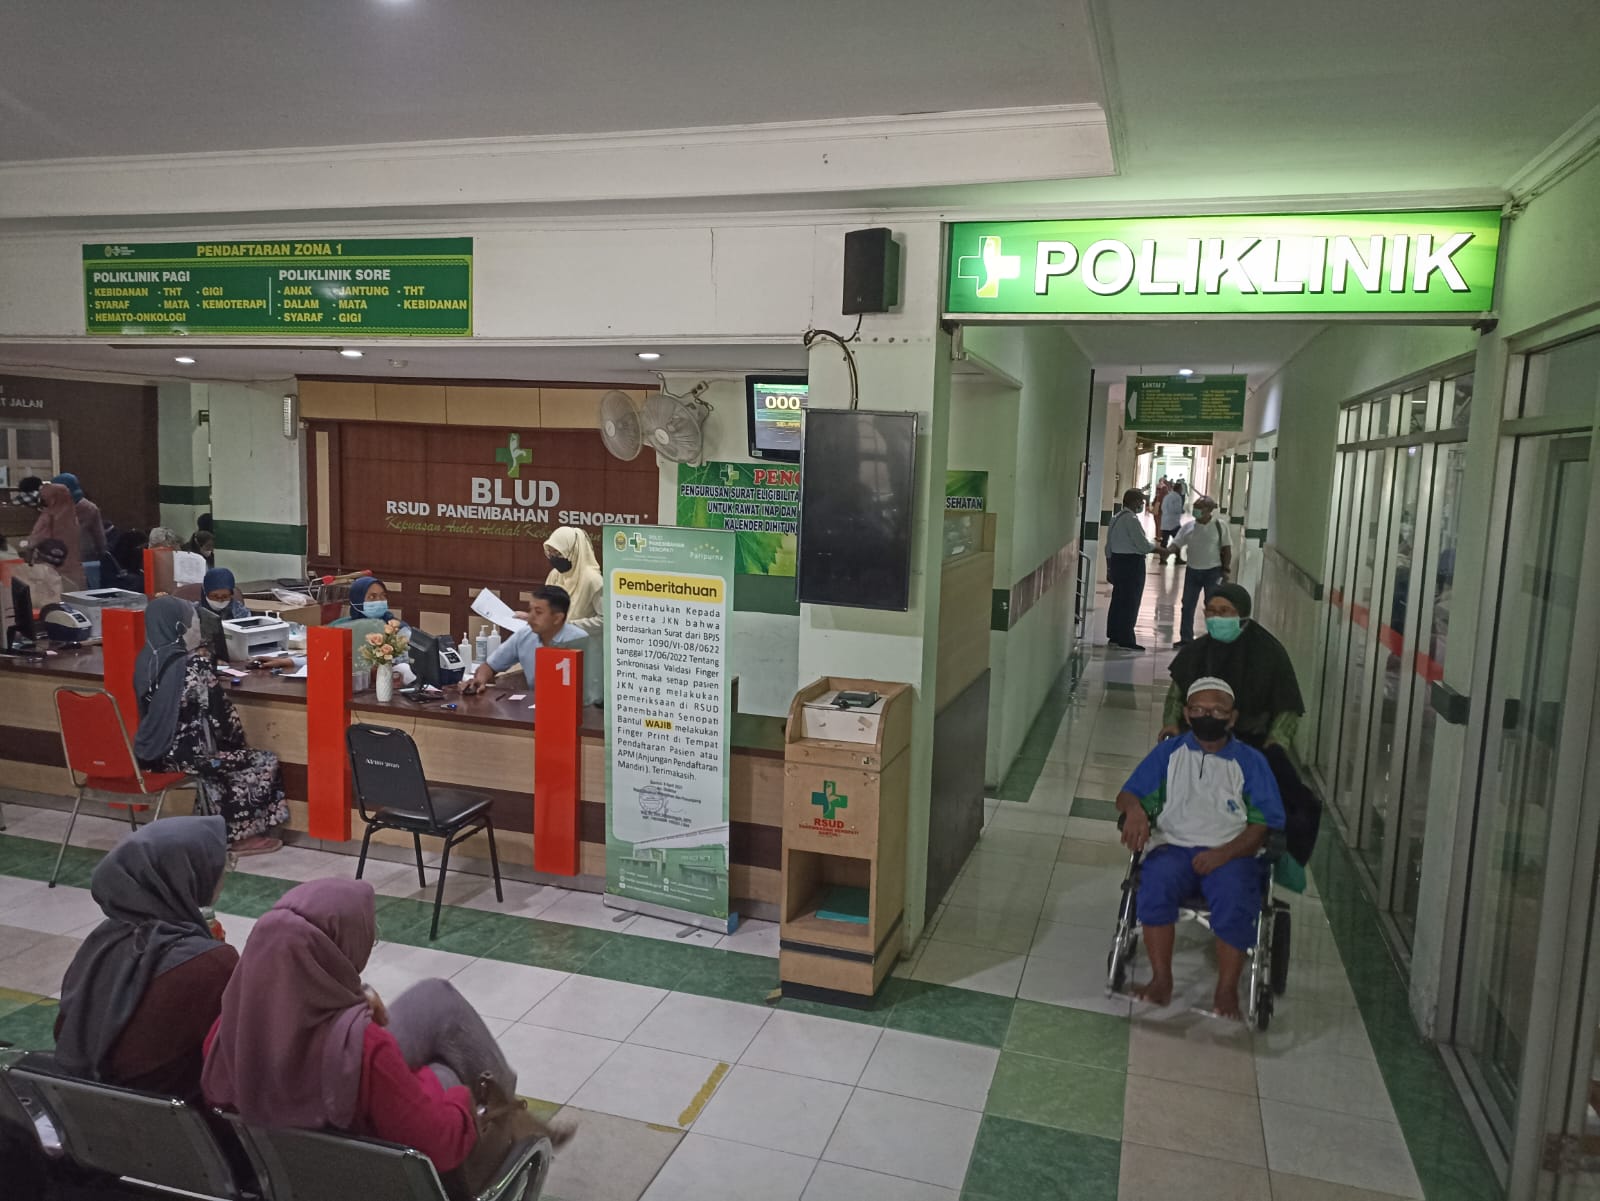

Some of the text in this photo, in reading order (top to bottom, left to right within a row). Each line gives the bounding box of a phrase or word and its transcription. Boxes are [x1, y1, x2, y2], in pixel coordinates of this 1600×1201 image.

[196, 243, 342, 257] PENDAFTARAN ZONA 1
[1034, 233, 1475, 296] POLIKLINIK
[93, 270, 190, 283] POLIKLINIK PAGI
[278, 269, 391, 281] POLIKLINIK SORE
[94, 286, 223, 297] KEBIDANAN THT GIGI
[283, 286, 425, 296] ANAK JANTUNG THT
[95, 299, 266, 310] SYARAF MATA KEMOTERAPI
[283, 299, 467, 310] DALAM MATA KEBIDANAN
[95, 312, 186, 322] HEMATO-ONKOLOGI
[283, 312, 362, 323] SYARAF GIGI
[765, 395, 800, 410] 000
[471, 477, 560, 507] BLUD
[681, 484, 729, 498] PENGURUSAN
[730, 486, 755, 500] SURAT
[386, 500, 640, 527] RSUD PANEMBAHAN SENOPATI
[707, 501, 798, 518] UNTUK RAWAT INAP DAN
[724, 517, 764, 531] KALENDER
[618, 577, 718, 598] Pemberitahuan
[616, 600, 720, 618] Diberitahukan Kepada
[616, 612, 720, 630] Peserta JKN bahwa
[616, 624, 720, 642] berdasarkan Surat dari BPJS
[616, 635, 720, 654] Nomor 1090/VI-08/0622
[616, 647, 719, 668] tanggal 17/06/2022 Tentang
[555, 657, 571, 686] 1
[616, 658, 660, 671] Sinkronisasi
[695, 667, 719, 679] Finger
[617, 669, 719, 690] Print, maka setiap pasien
[617, 681, 719, 702] JKN yang melakukan
[617, 693, 719, 714] pemeriksaan di RSUD
[617, 703, 719, 725] Panembahan Senopati
[617, 715, 719, 737] Bantul WAJIB melakukan
[617, 726, 719, 749] Finger Print di Tempat
[617, 737, 718, 761] Pendaftaran Pasien atau
[652, 765, 697, 781] Terimakasih.
[673, 757, 718, 773] Pendaftaran
[814, 817, 845, 829] RSUD
